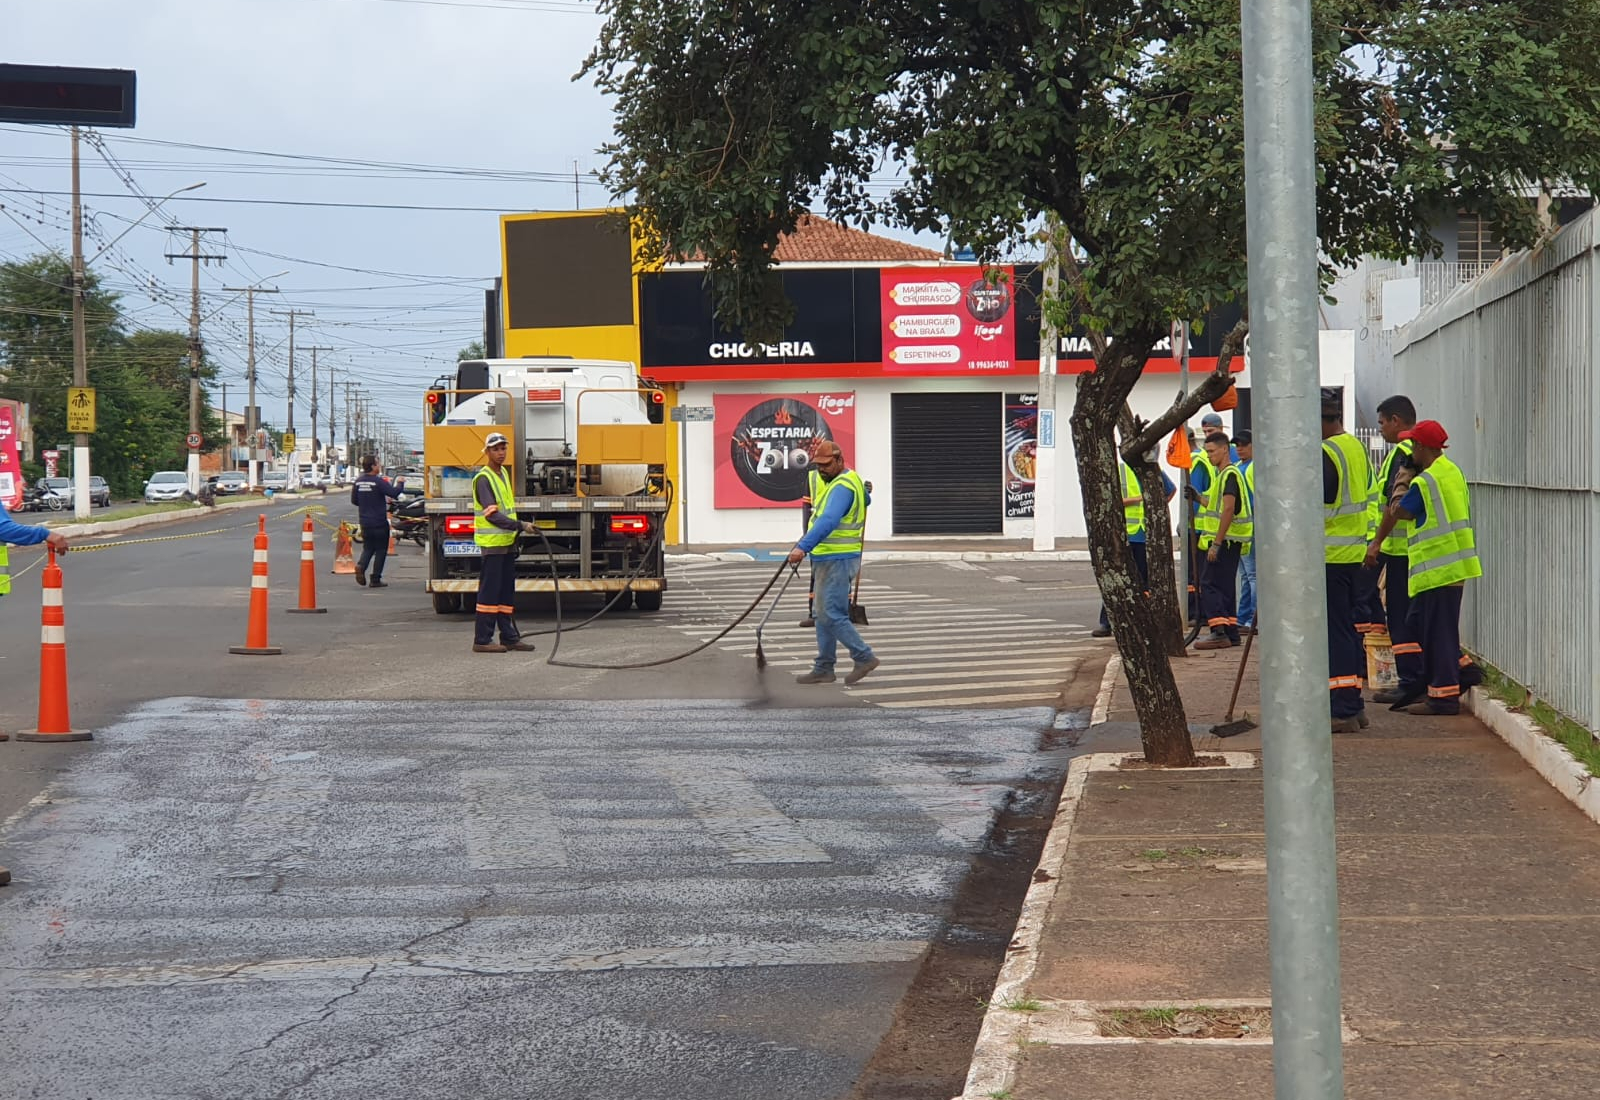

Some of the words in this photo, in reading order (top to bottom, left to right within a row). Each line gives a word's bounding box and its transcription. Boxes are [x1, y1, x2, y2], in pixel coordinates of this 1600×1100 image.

[902, 295, 952, 303] CHURRASCO
[899, 318, 955, 326] HAMBURGUER
[903, 351, 952, 359] ESPETINHOS
[751, 427, 812, 439] ESPETARIA
[189, 435, 199, 444] 30
